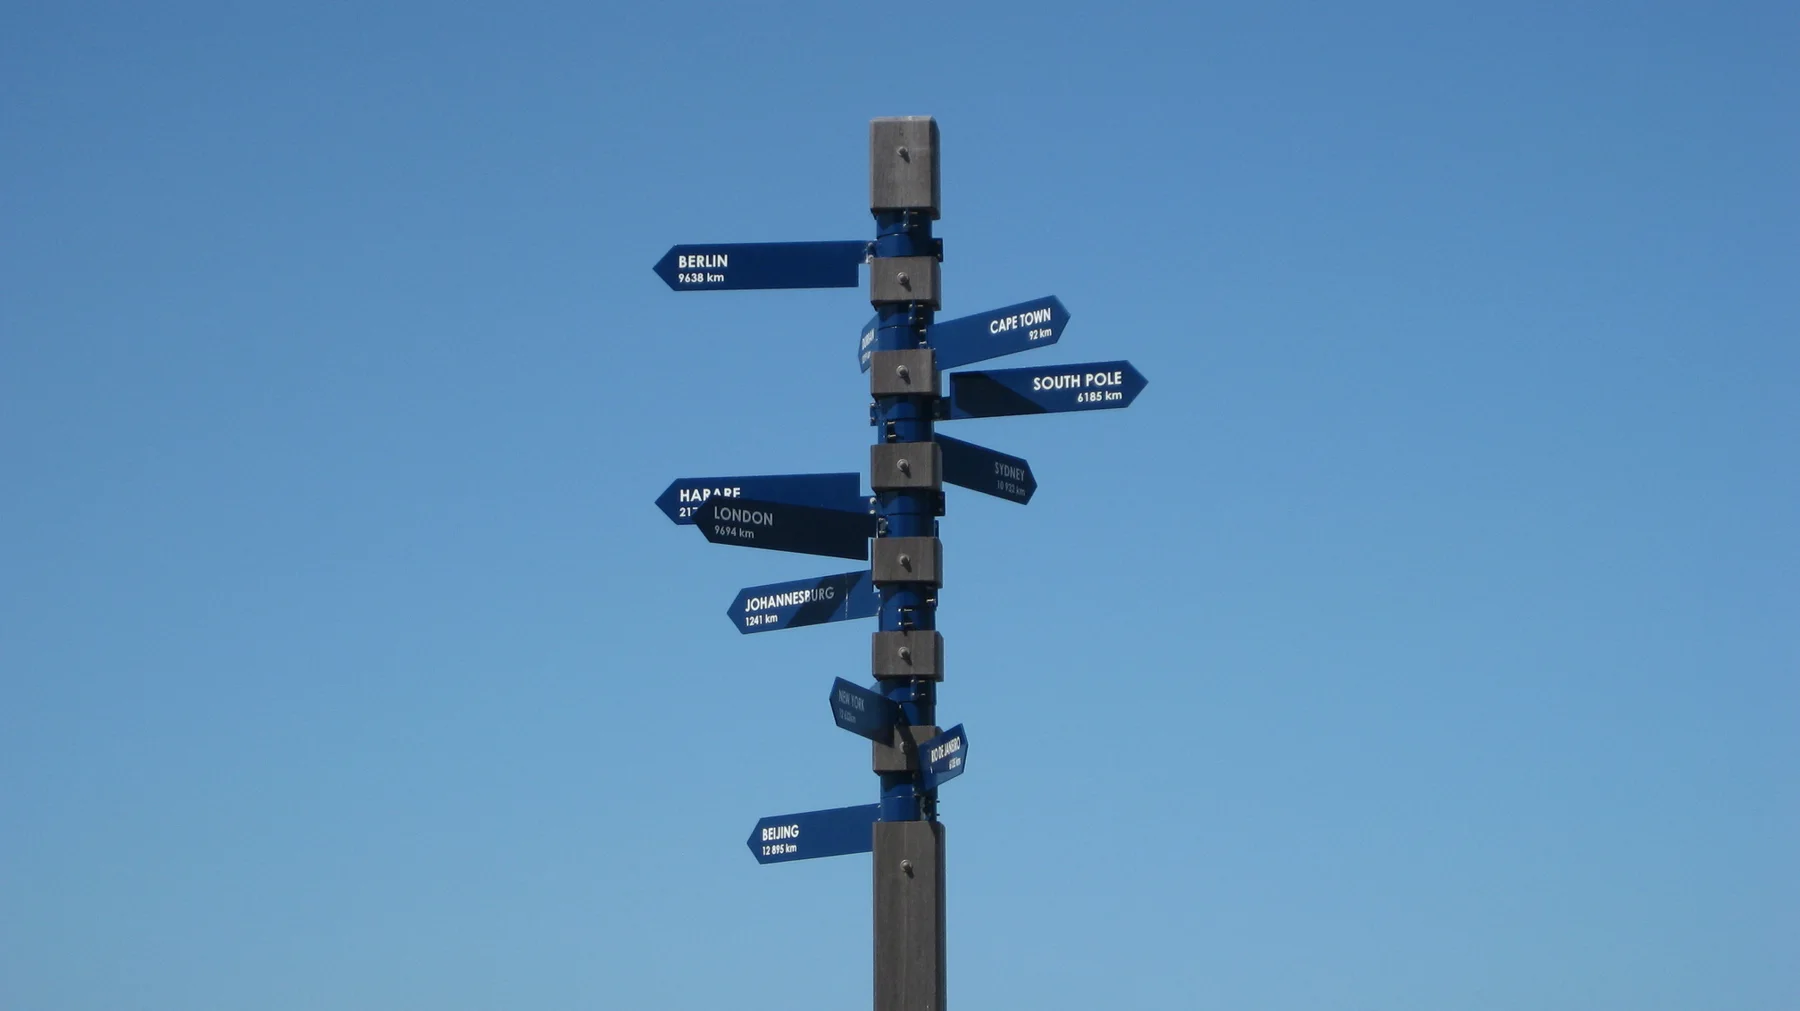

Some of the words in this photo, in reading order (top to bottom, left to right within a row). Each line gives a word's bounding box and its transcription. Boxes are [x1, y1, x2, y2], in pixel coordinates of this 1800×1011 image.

[678, 254, 728, 268] BERLIN
[678, 273, 704, 283] 9638
[706, 272, 724, 282] km
[990, 314, 1018, 334] CAPE
[1019, 308, 1051, 328] TOWN
[1029, 330, 1038, 340] 92
[1039, 328, 1052, 338] km
[1033, 375, 1081, 391] SOUTH
[1085, 371, 1122, 387] POLE
[1077, 391, 1102, 403] 6185
[1105, 390, 1122, 401] km
[994, 461, 1025, 481] SYDNEY
[714, 505, 773, 526] LONDON
[714, 524, 737, 536] 9694
[739, 527, 754, 539] km
[745, 586, 835, 612] JOHANNESBURG
[745, 615, 763, 626] 1241
[765, 614, 778, 624] km
[762, 824, 800, 841] BEIJING
[762, 846, 770, 856] 12
[771, 844, 785, 854] 895
[785, 843, 797, 853] km
